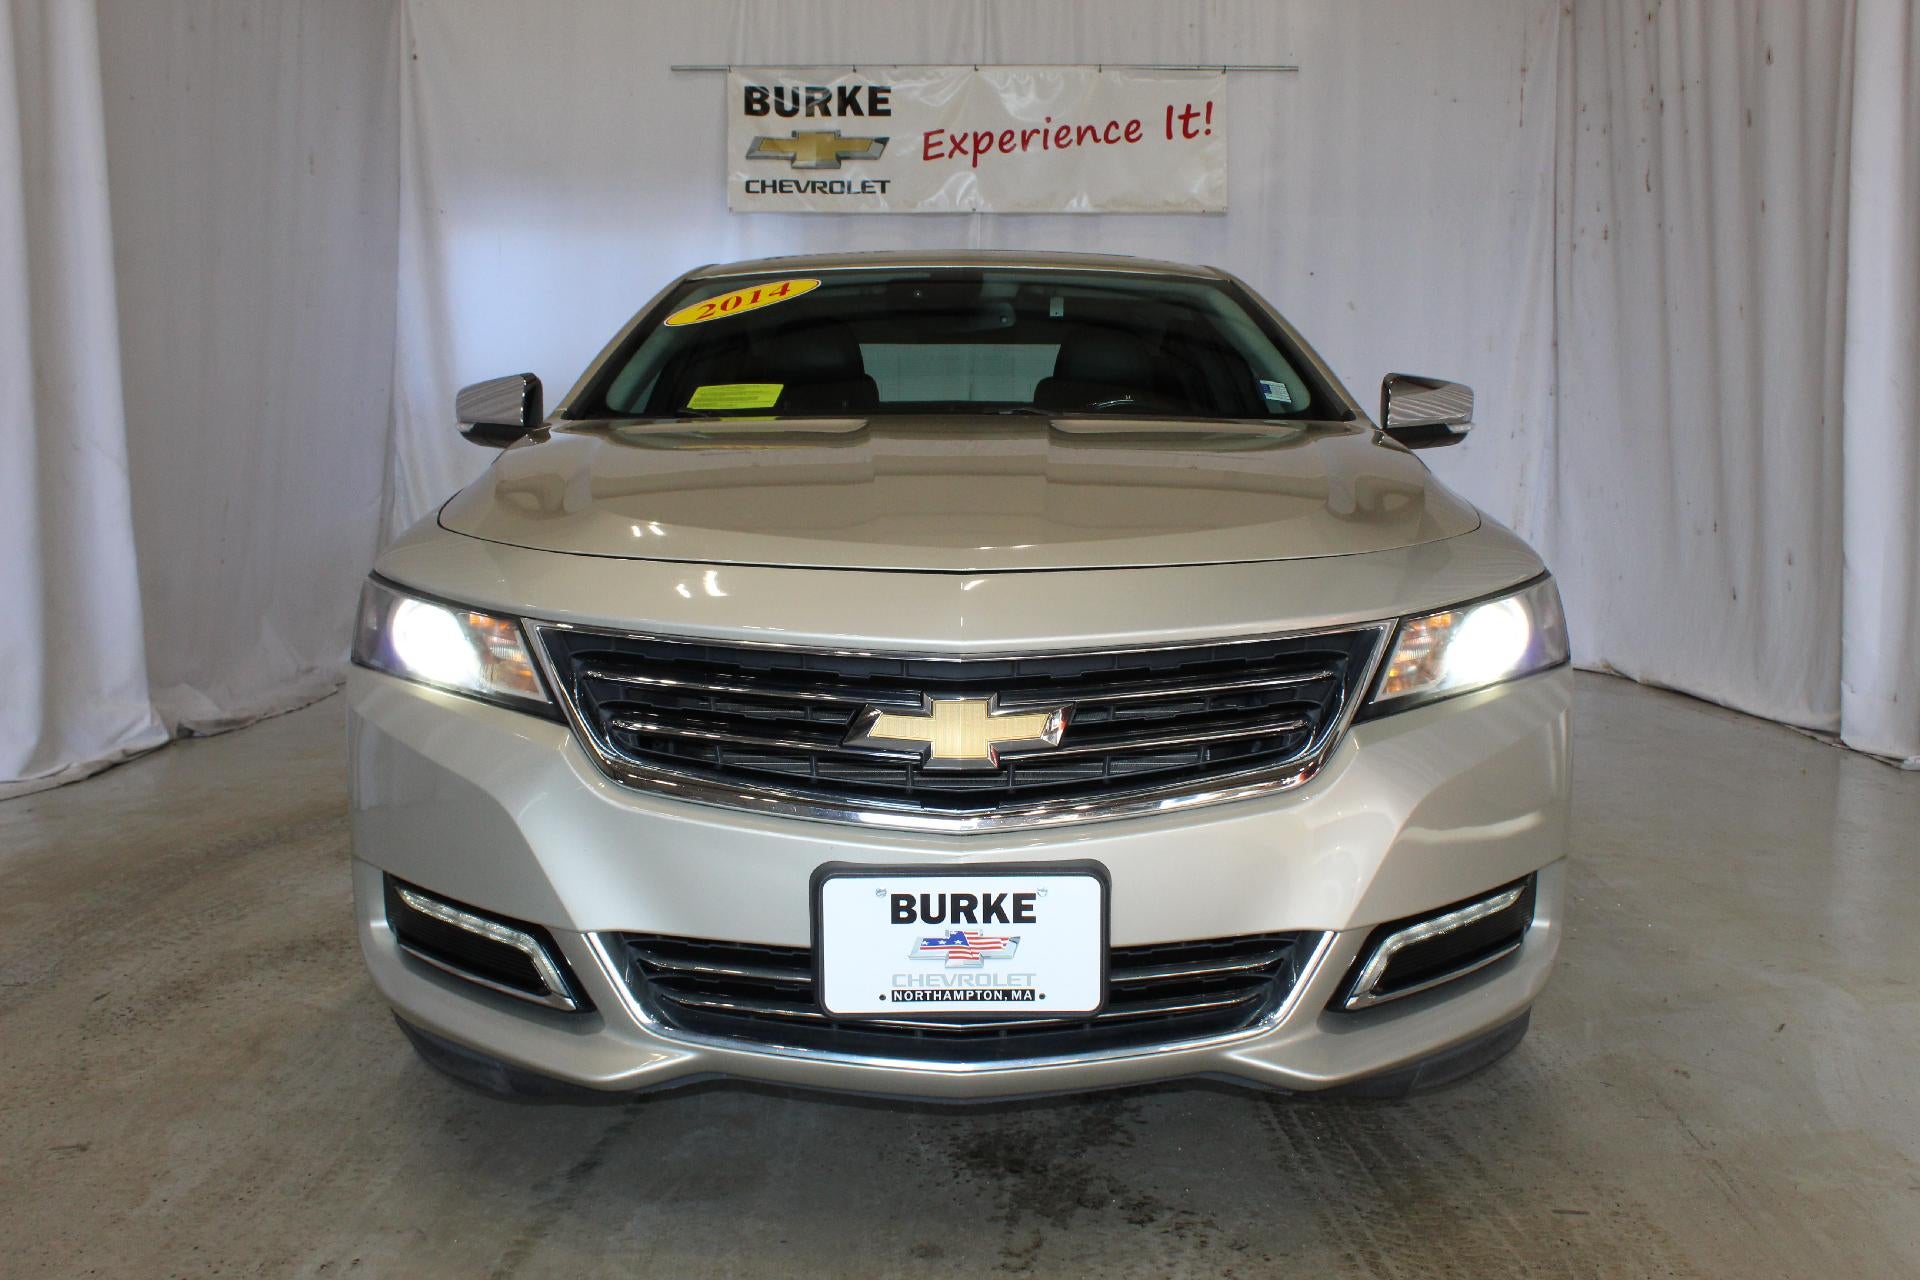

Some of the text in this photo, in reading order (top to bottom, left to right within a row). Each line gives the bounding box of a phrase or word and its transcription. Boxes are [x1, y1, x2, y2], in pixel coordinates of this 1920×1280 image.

[744, 85, 892, 117] BURKE
[922, 101, 1214, 167] Experience It!
[745, 178, 891, 195] CHEVROLET
[697, 283, 791, 319] 2014
[891, 893, 1037, 924] BURKE
[892, 973, 1037, 987] CHEVROLET
